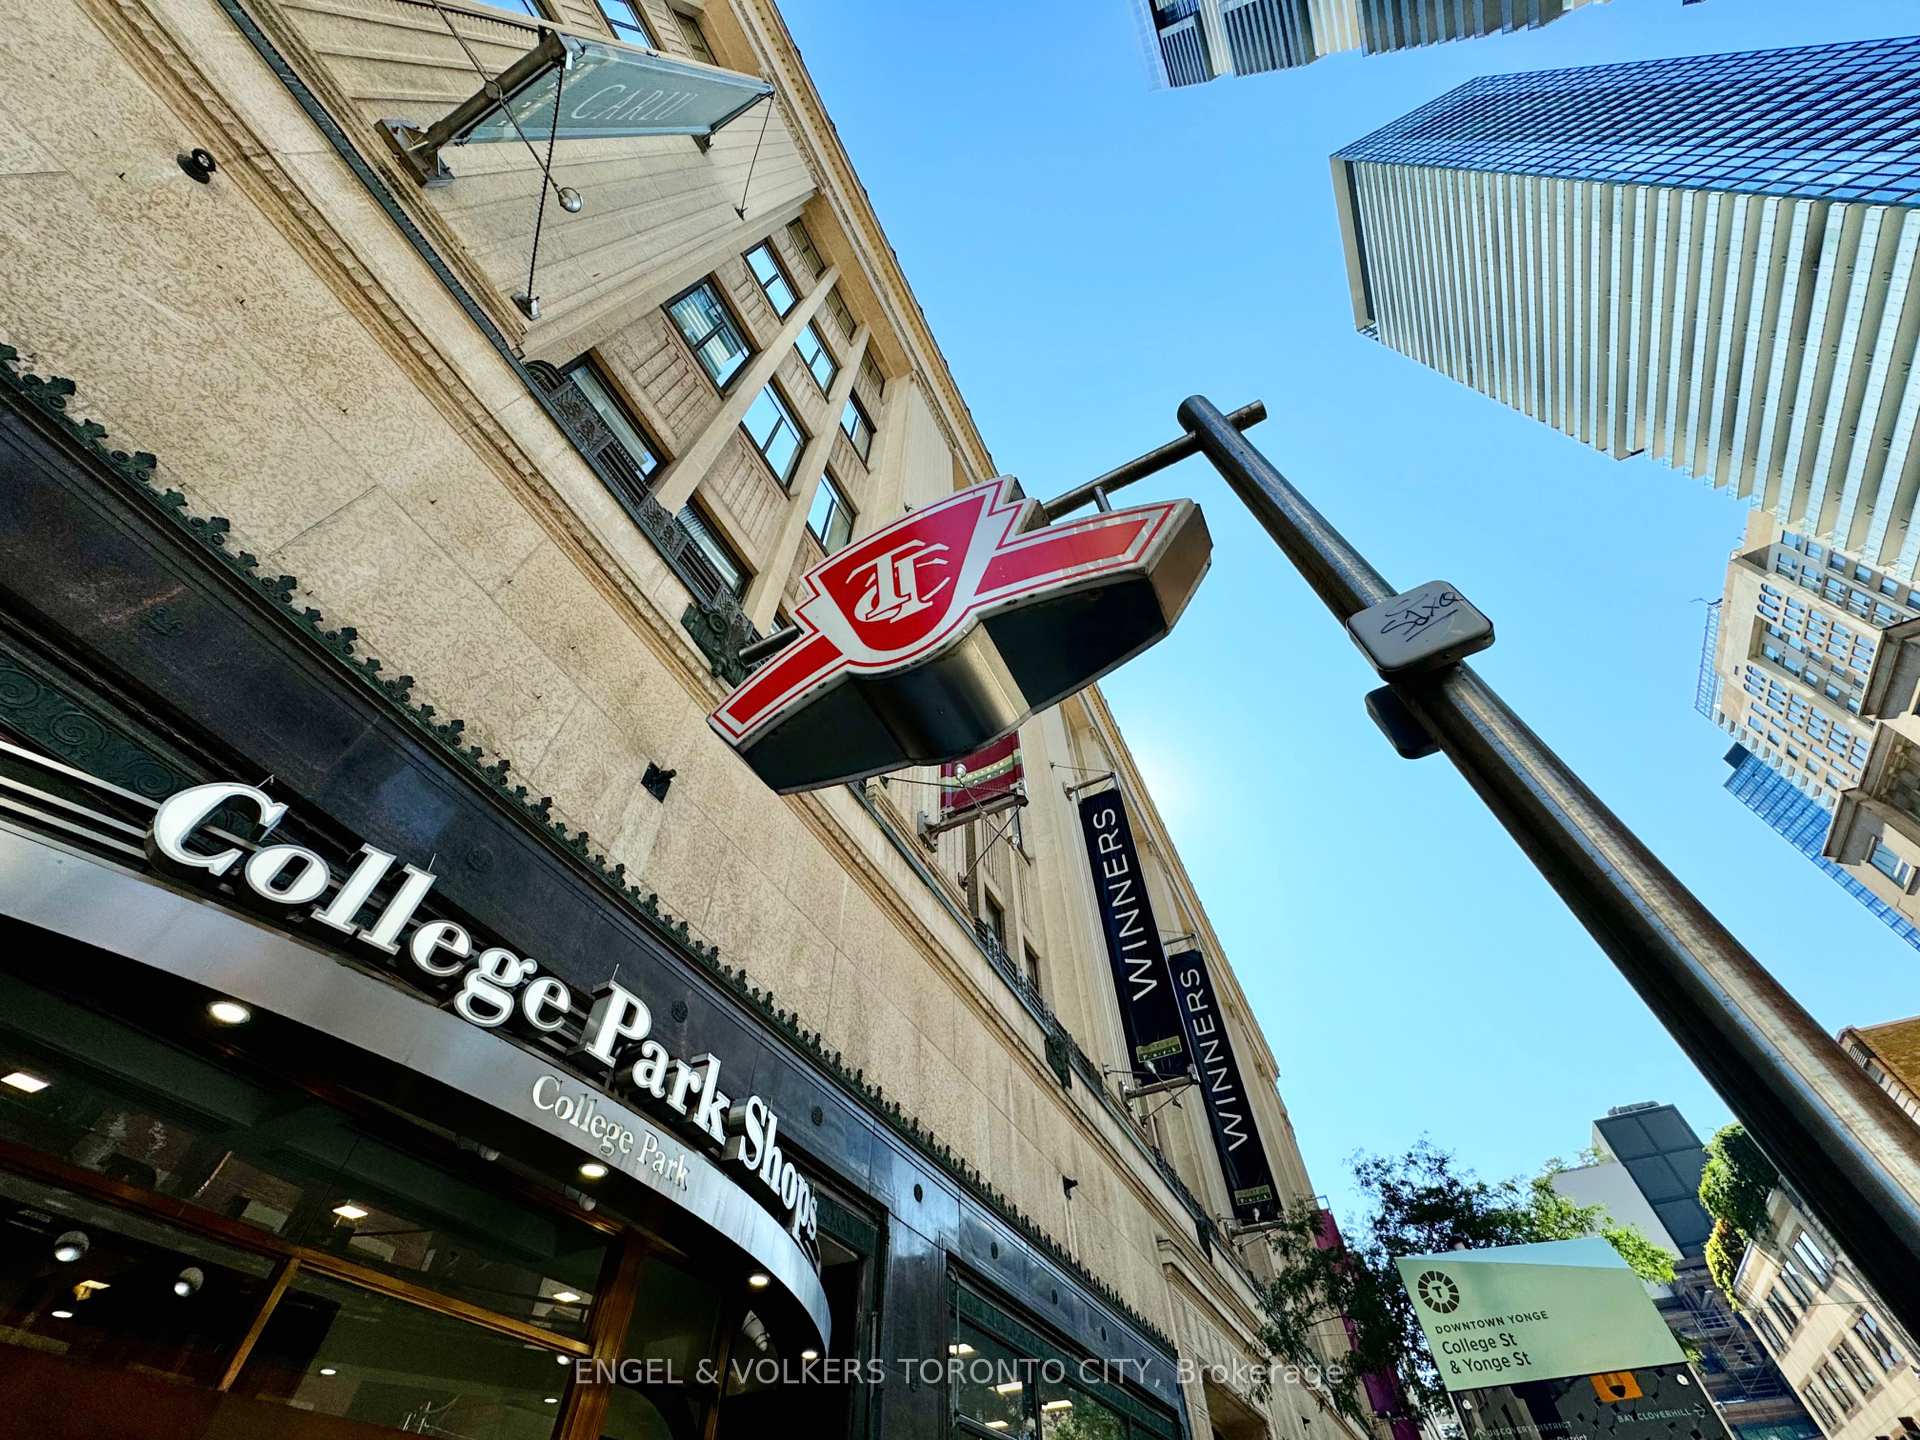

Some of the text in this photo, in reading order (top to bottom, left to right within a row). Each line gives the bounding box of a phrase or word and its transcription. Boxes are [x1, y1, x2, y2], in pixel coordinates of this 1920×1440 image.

[1093, 808, 1158, 1001] WINNERS
[153, 782, 818, 1238] College Park Shops
[1180, 968, 1248, 1151] WINNERS
[532, 1075, 690, 1191] College Park
[1435, 1310, 1549, 1335] DOWNTOWN YONGE
[1442, 1332, 1518, 1355] College St
[1450, 1351, 1532, 1375] & Yonge St
[1617, 1408, 1691, 1423] BAY CLOVERHILL
